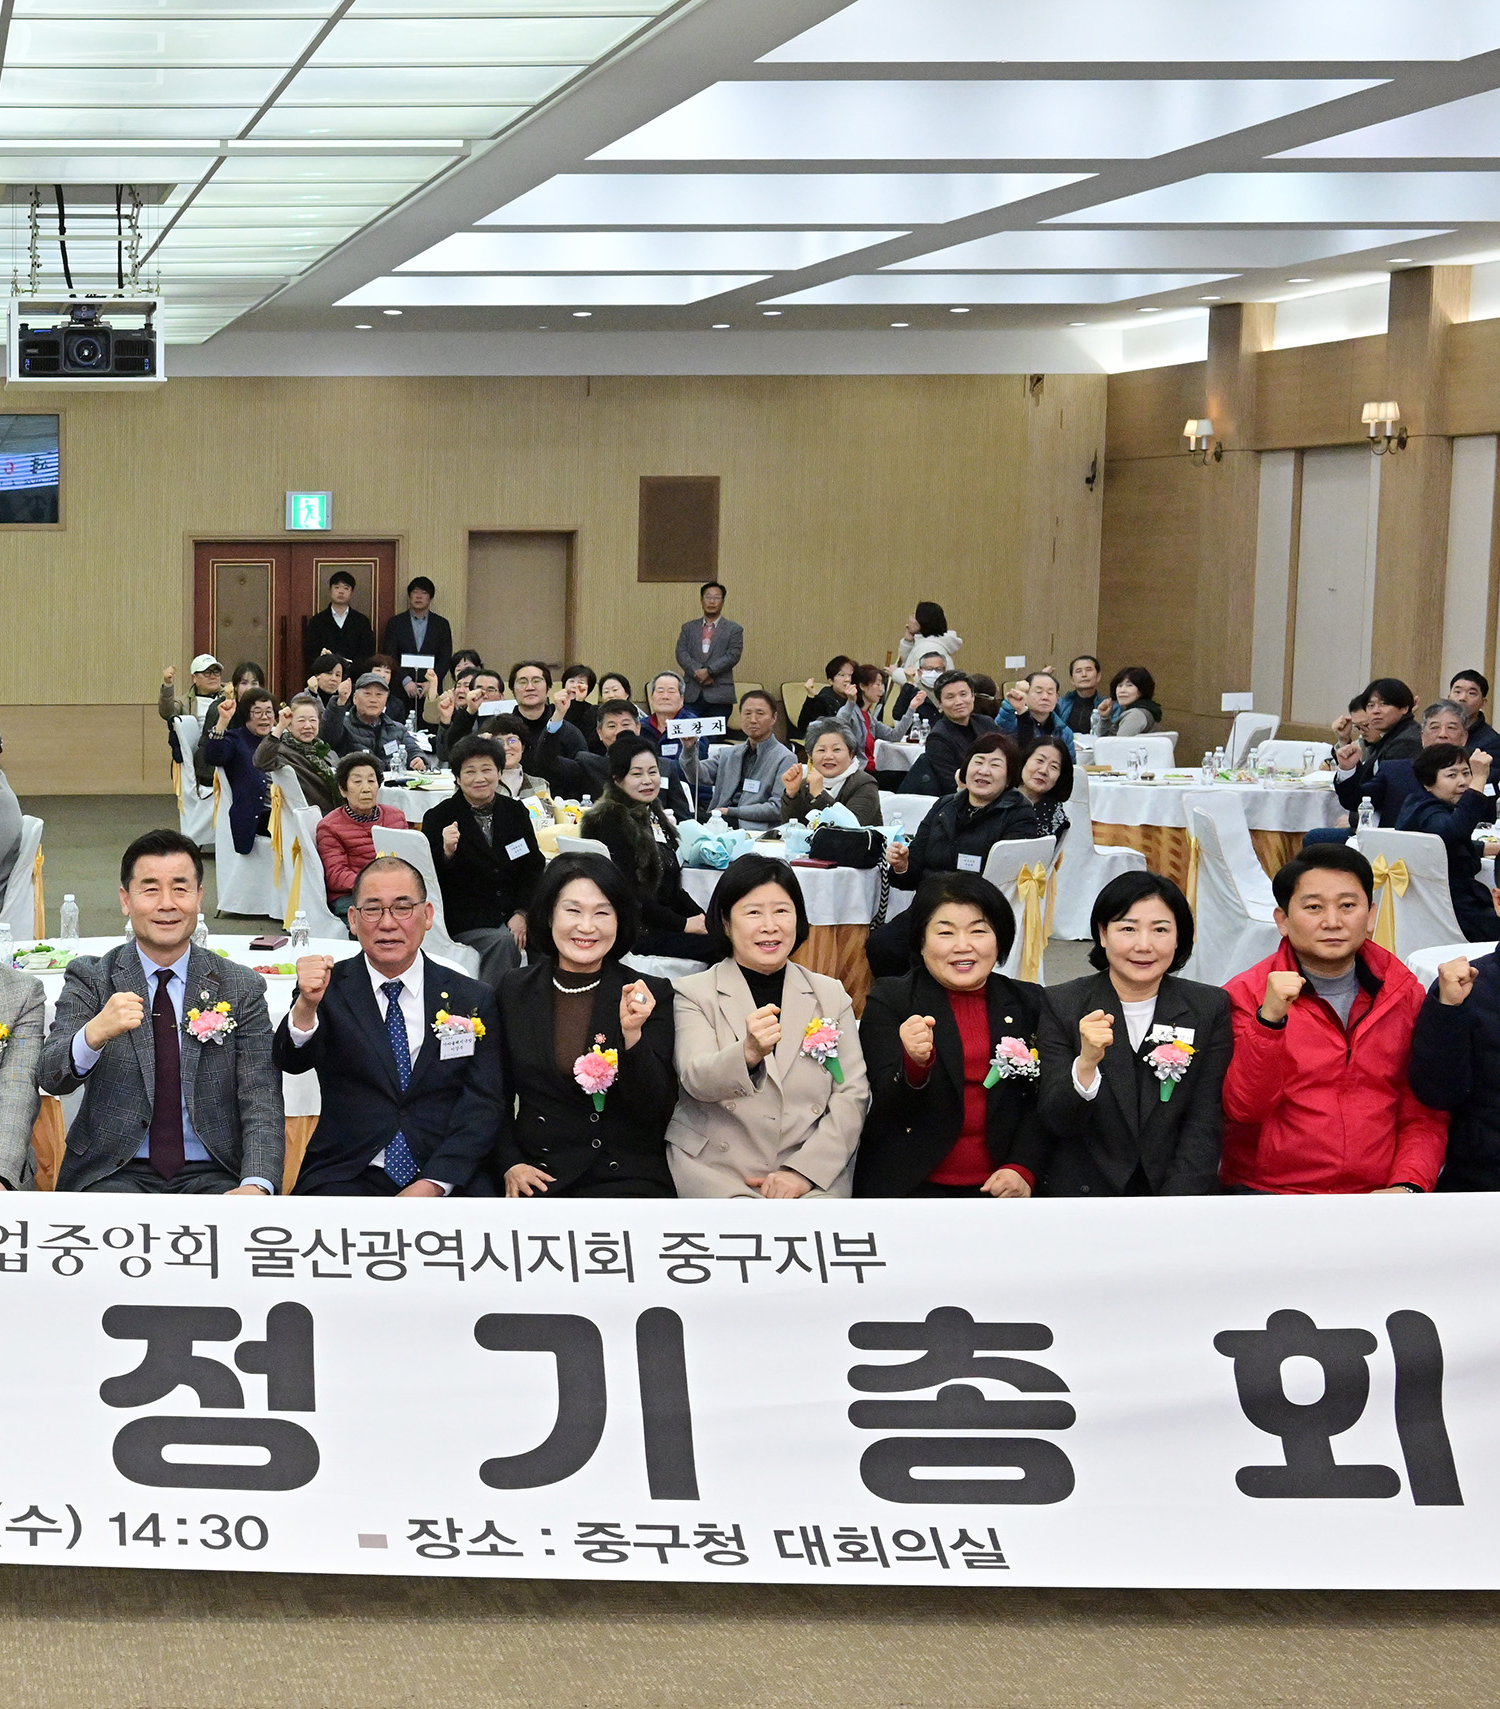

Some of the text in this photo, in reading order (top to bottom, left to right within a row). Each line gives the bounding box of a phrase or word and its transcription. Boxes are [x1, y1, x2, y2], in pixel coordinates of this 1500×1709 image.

[244, 1226, 635, 1283] 울산광역시지회
[658, 1230, 887, 1285] 중구지부
[108, 1512, 269, 1551] 14:30
[407, 1517, 524, 1560] 장소
[575, 1522, 750, 1566] 중구청
[774, 1525, 1011, 1570] 대회의실
